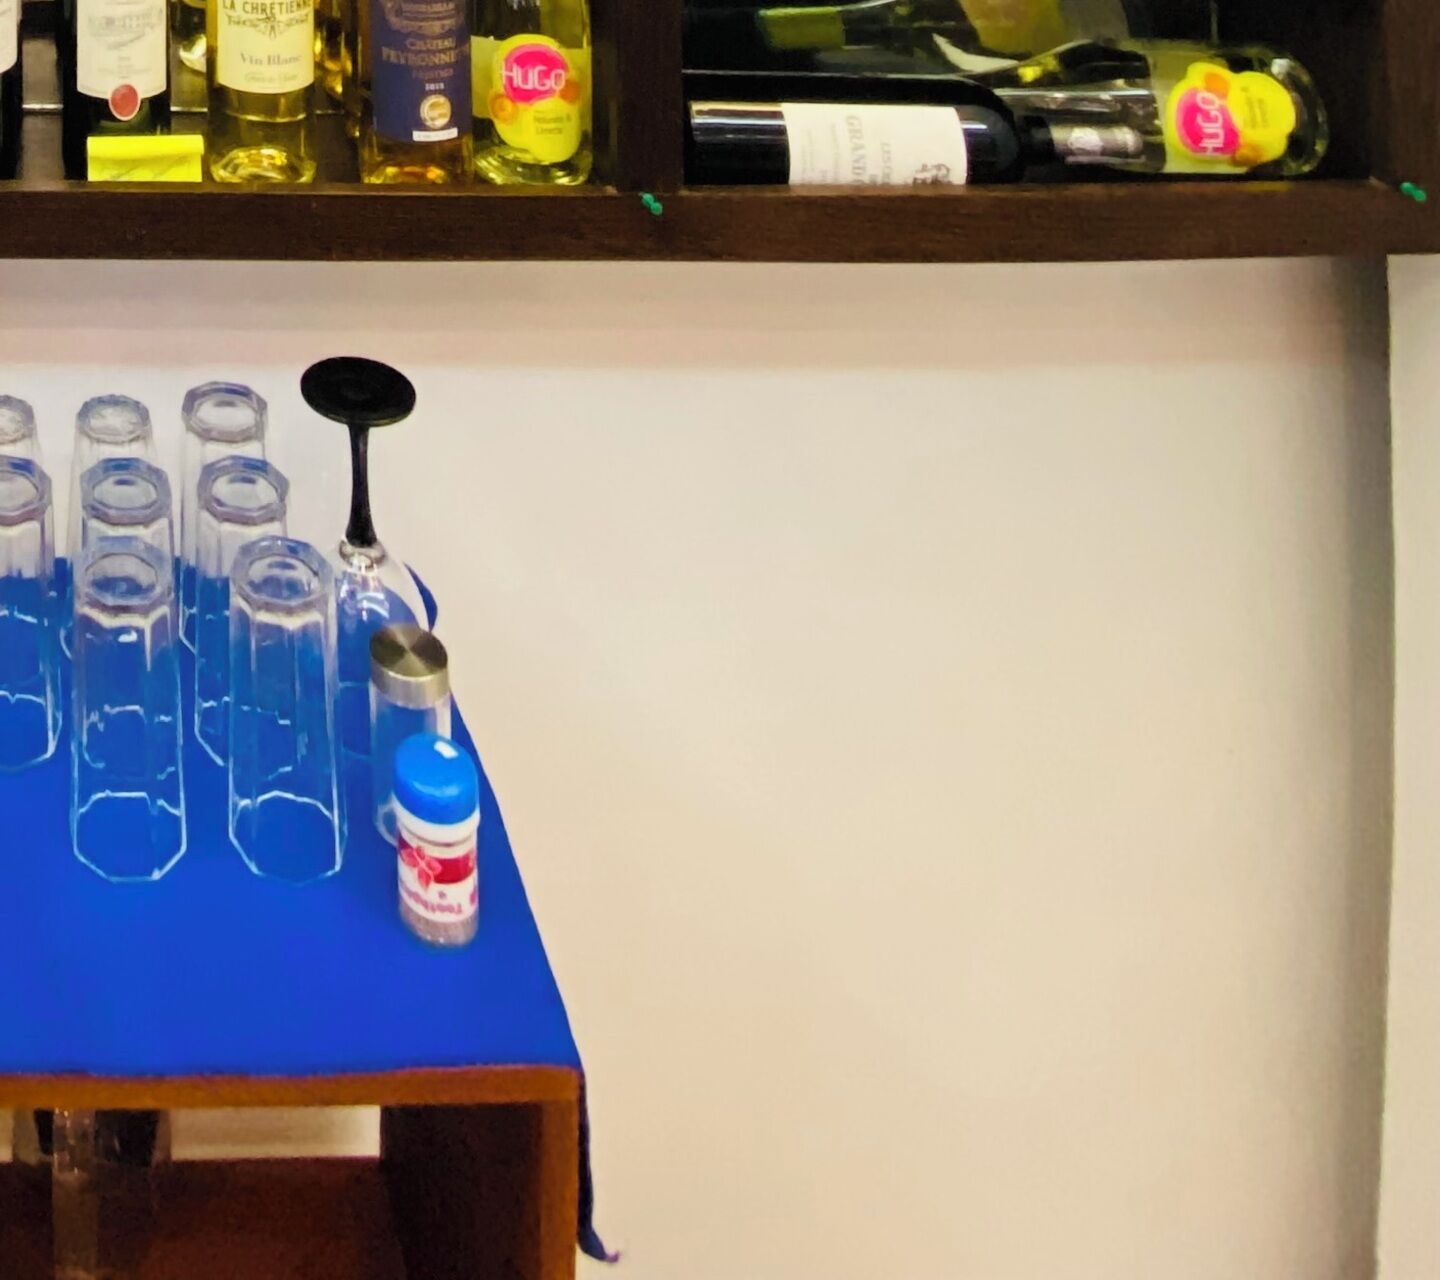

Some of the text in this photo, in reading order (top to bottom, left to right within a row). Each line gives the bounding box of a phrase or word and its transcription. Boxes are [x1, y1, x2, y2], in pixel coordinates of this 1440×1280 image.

[239, 52, 303, 66] Vin Blanc
[501, 62, 566, 91] HUGO
